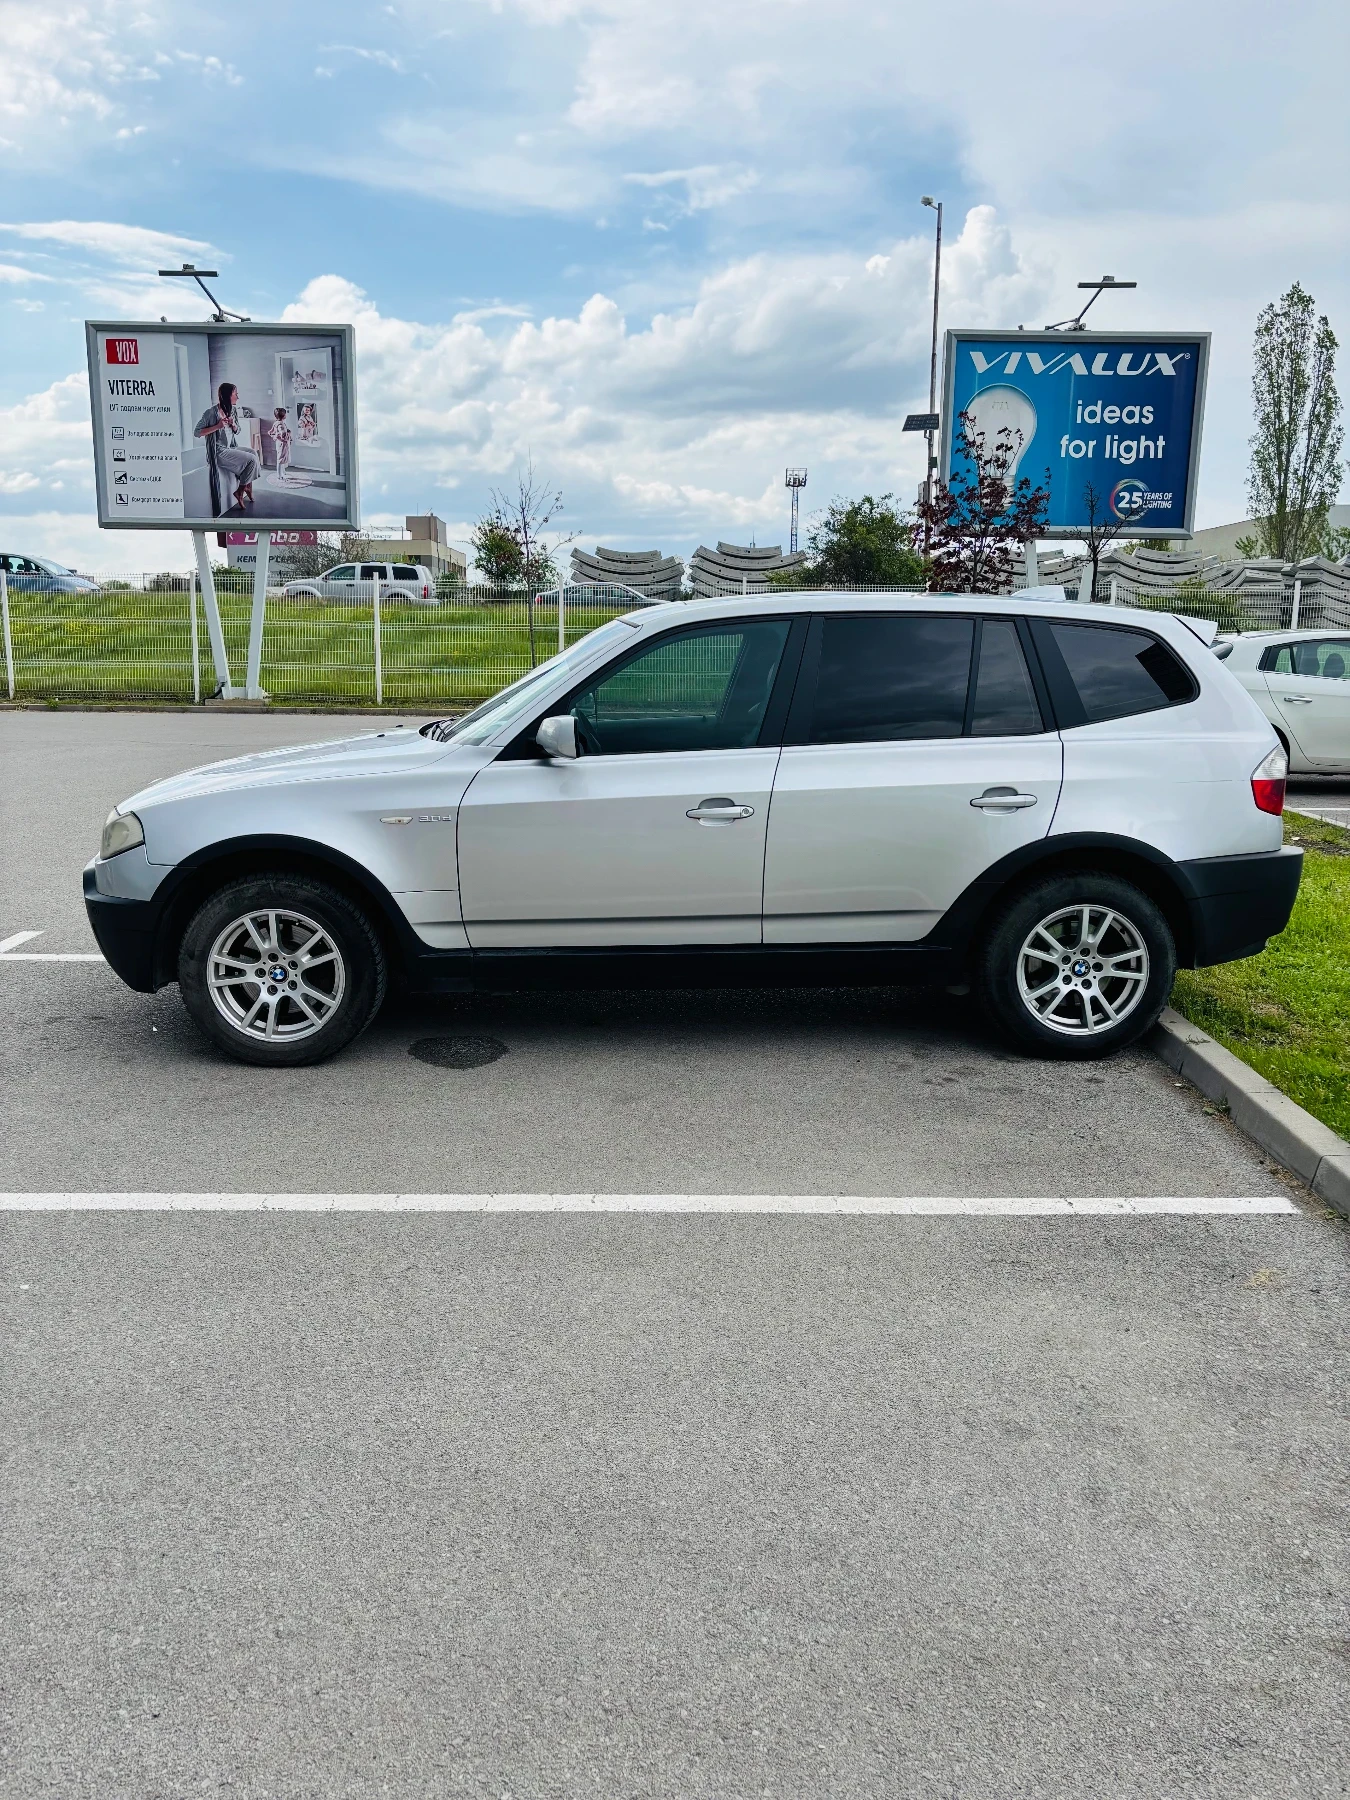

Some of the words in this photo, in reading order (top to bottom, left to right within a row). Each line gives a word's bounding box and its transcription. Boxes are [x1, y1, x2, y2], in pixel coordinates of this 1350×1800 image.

[115, 341, 137, 363] VOX
[107, 379, 156, 396] VITERRA
[1076, 399, 1155, 425] ideas
[1060, 433, 1097, 459] for
[1104, 434, 1166, 465] light
[1117, 491, 1143, 509] 25
[1143, 492, 1163, 500] YEARS
[1163, 492, 1173, 500] OF
